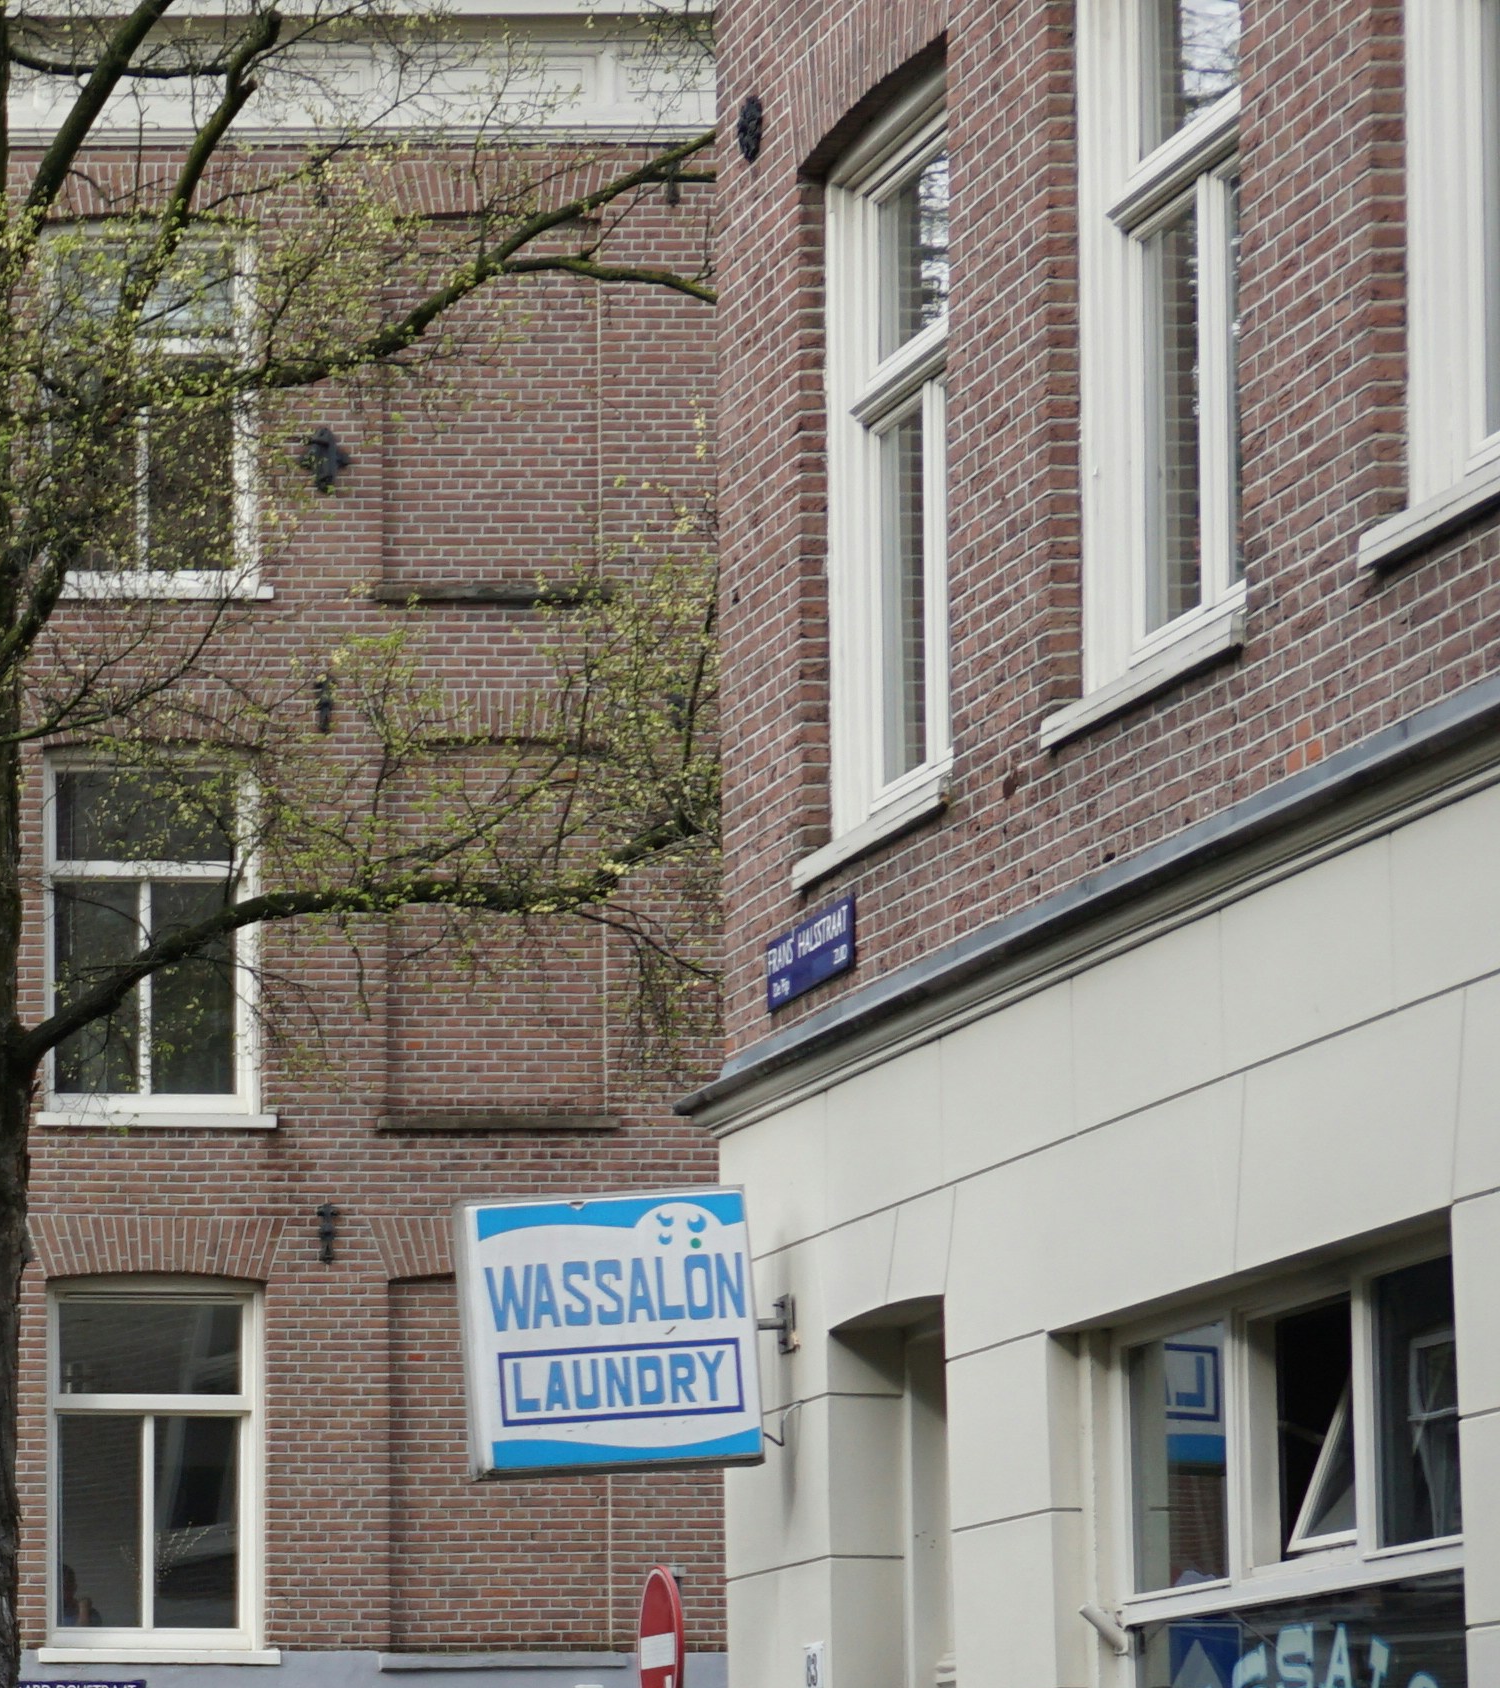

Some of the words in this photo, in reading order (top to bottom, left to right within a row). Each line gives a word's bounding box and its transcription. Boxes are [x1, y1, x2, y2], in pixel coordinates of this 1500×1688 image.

[768, 938, 794, 977] FRANS
[797, 904, 849, 958] HALSSTRAAT
[484, 1252, 747, 1332] WASSALON
[513, 1351, 726, 1413] LAUNDRY
[807, 1653, 818, 1688] 83
